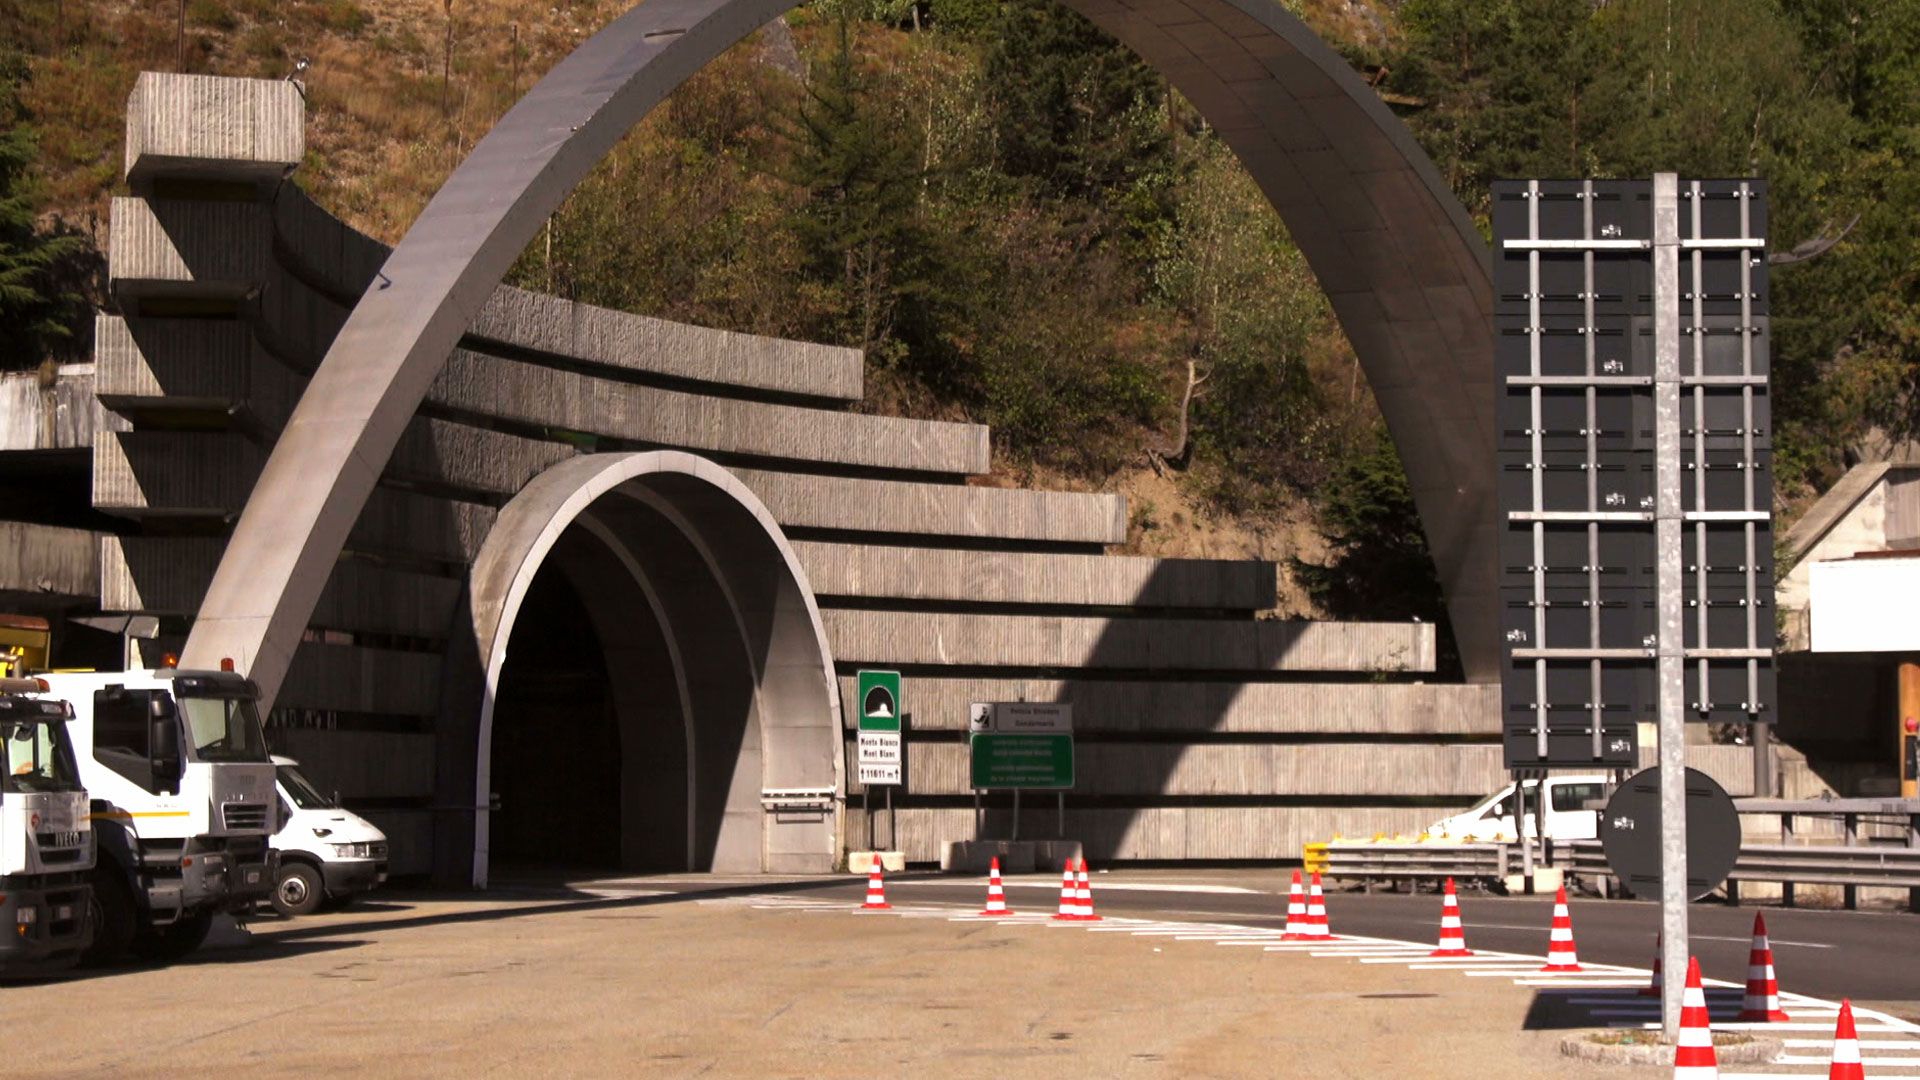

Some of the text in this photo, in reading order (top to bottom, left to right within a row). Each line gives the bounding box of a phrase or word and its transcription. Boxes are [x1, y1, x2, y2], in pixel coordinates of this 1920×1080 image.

[861, 738, 898, 746] Monte Bianco
[864, 749, 895, 758] Mont Blanc
[55, 831, 80, 847] IVECO
